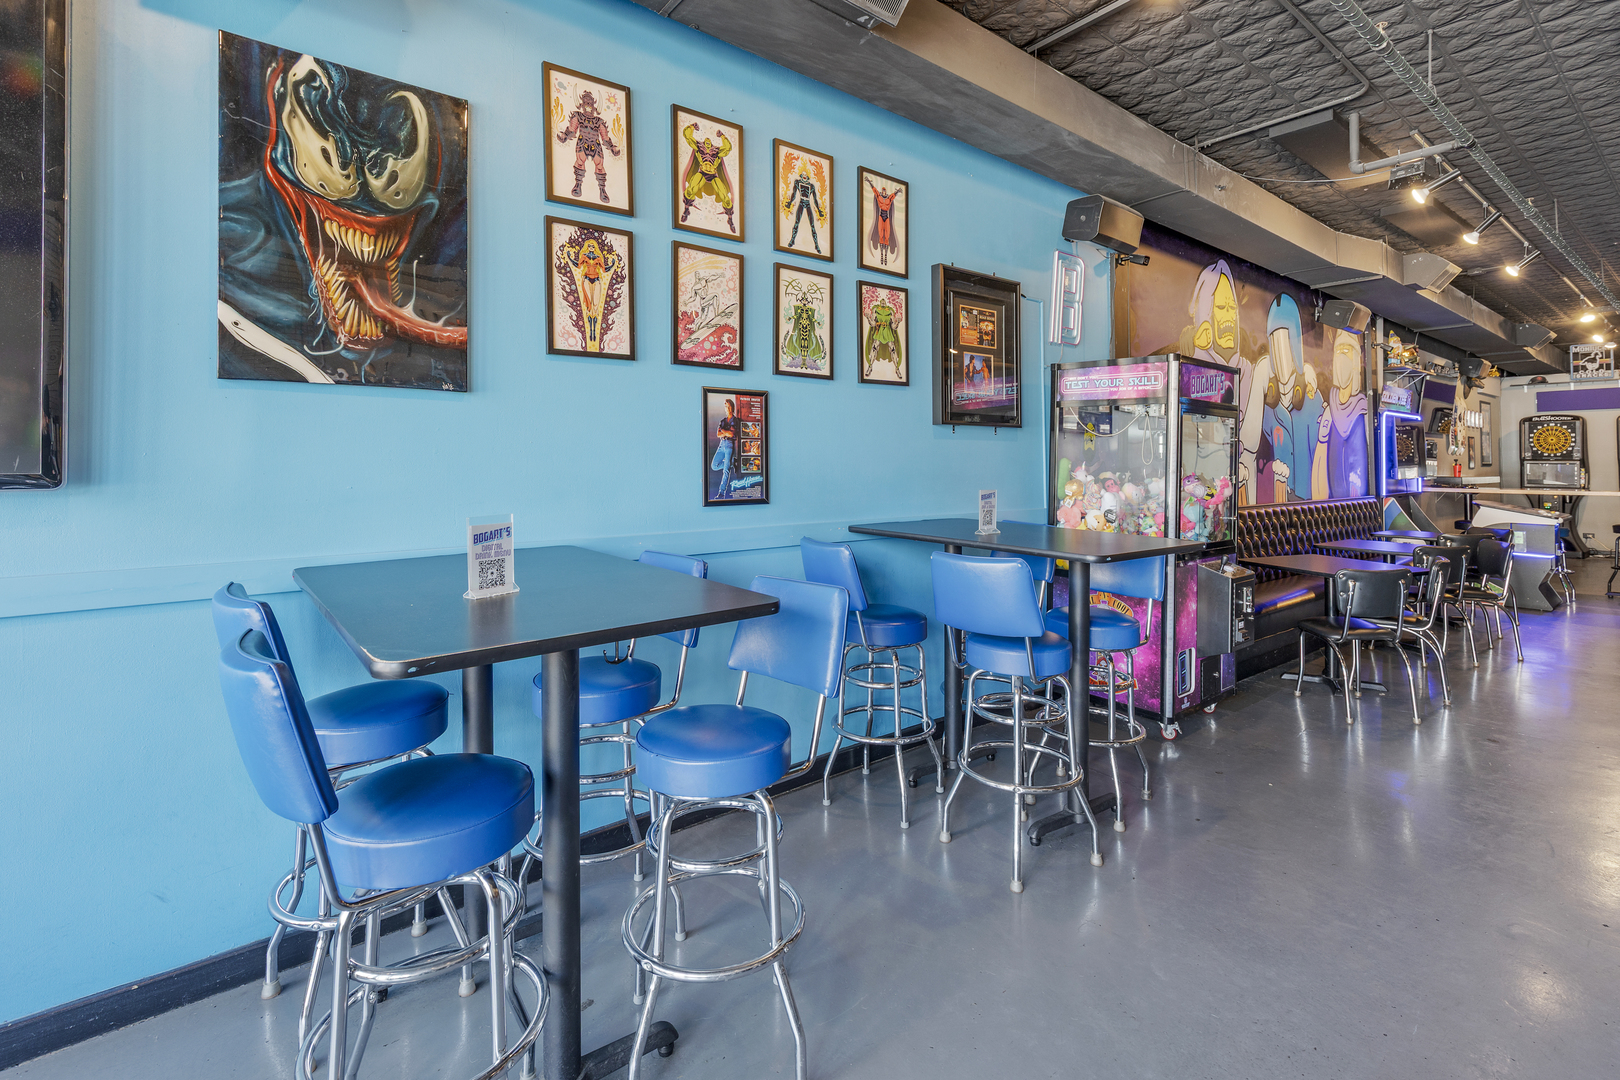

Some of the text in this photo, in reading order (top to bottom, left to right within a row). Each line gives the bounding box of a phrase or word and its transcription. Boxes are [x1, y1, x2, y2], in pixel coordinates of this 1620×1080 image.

[1066, 376, 1158, 389] TEST YOUR SKILL
[1191, 372, 1225, 398] BOGART'S
[474, 526, 512, 546] BOGART'S
[482, 543, 503, 552] DIGITAL
[475, 549, 511, 560] DRINK MENU
